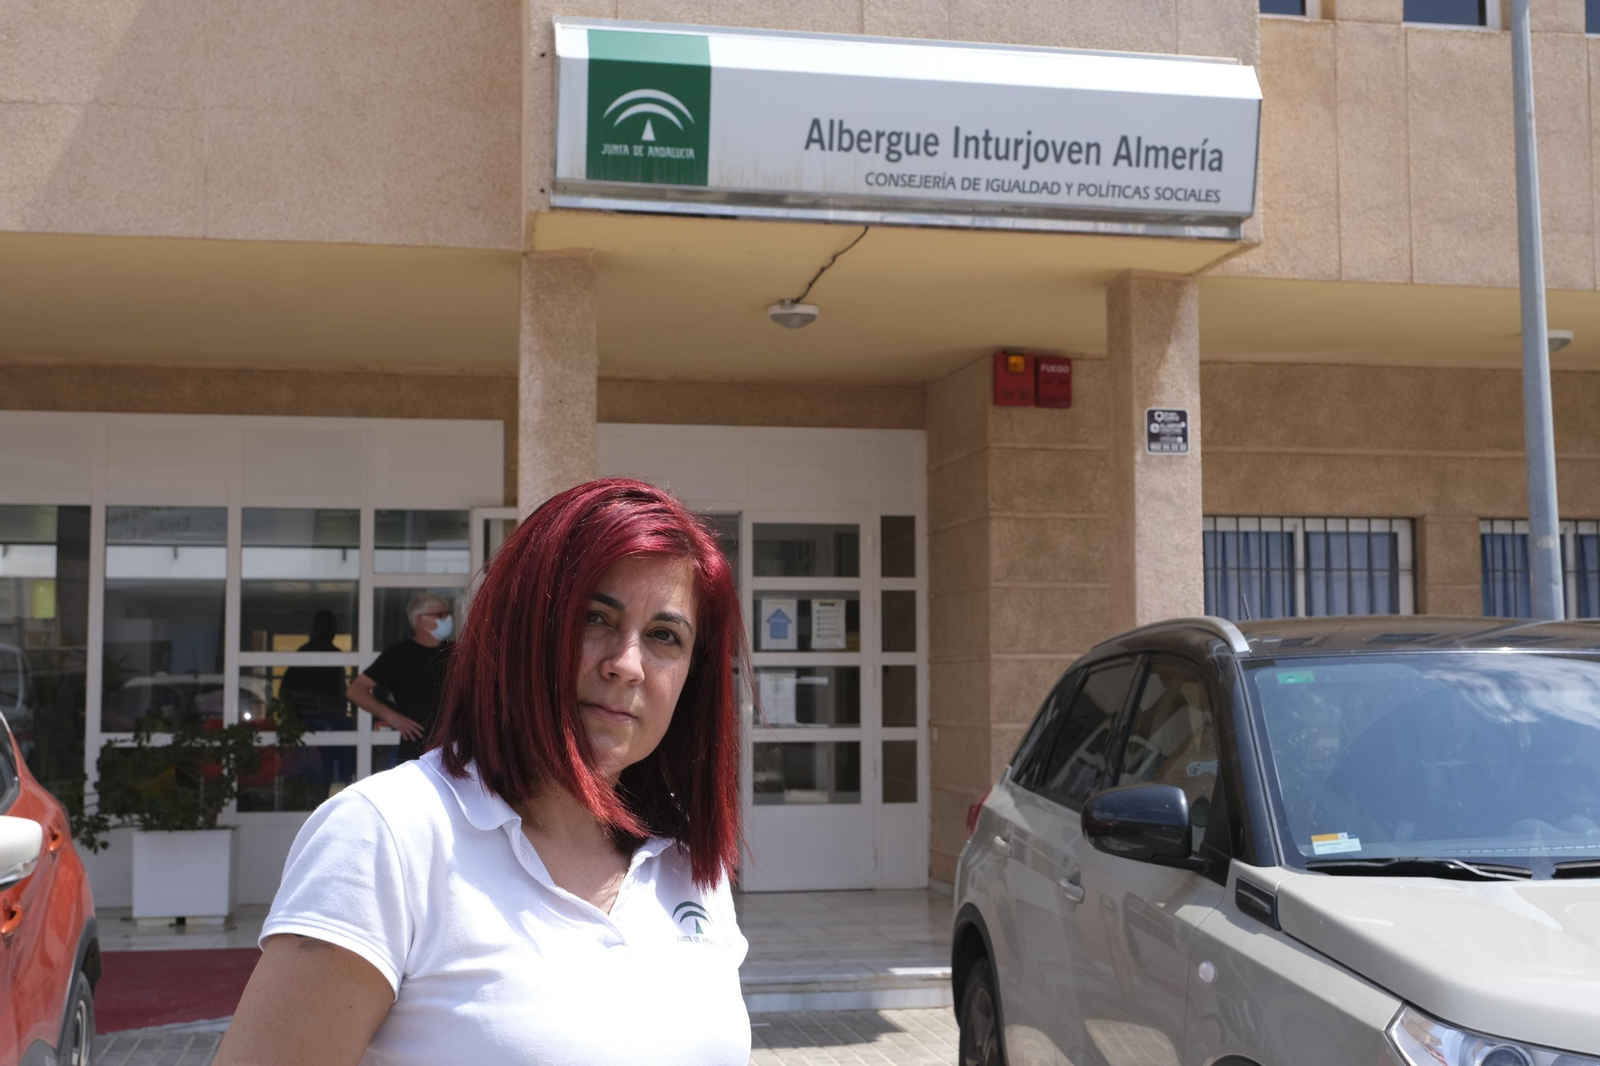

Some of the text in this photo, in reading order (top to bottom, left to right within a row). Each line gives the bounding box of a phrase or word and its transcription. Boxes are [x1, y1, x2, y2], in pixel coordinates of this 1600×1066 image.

[601, 143, 630, 156] JUNTA
[633, 145, 645, 157] DE
[804, 118, 1224, 173] Albergue Inturjoven Almería
[865, 171, 1221, 203] CONSEJERÍA DE IGUALDAD Y POLÍTICAS SOCIALES
[1040, 364, 1070, 374] FUEGO
